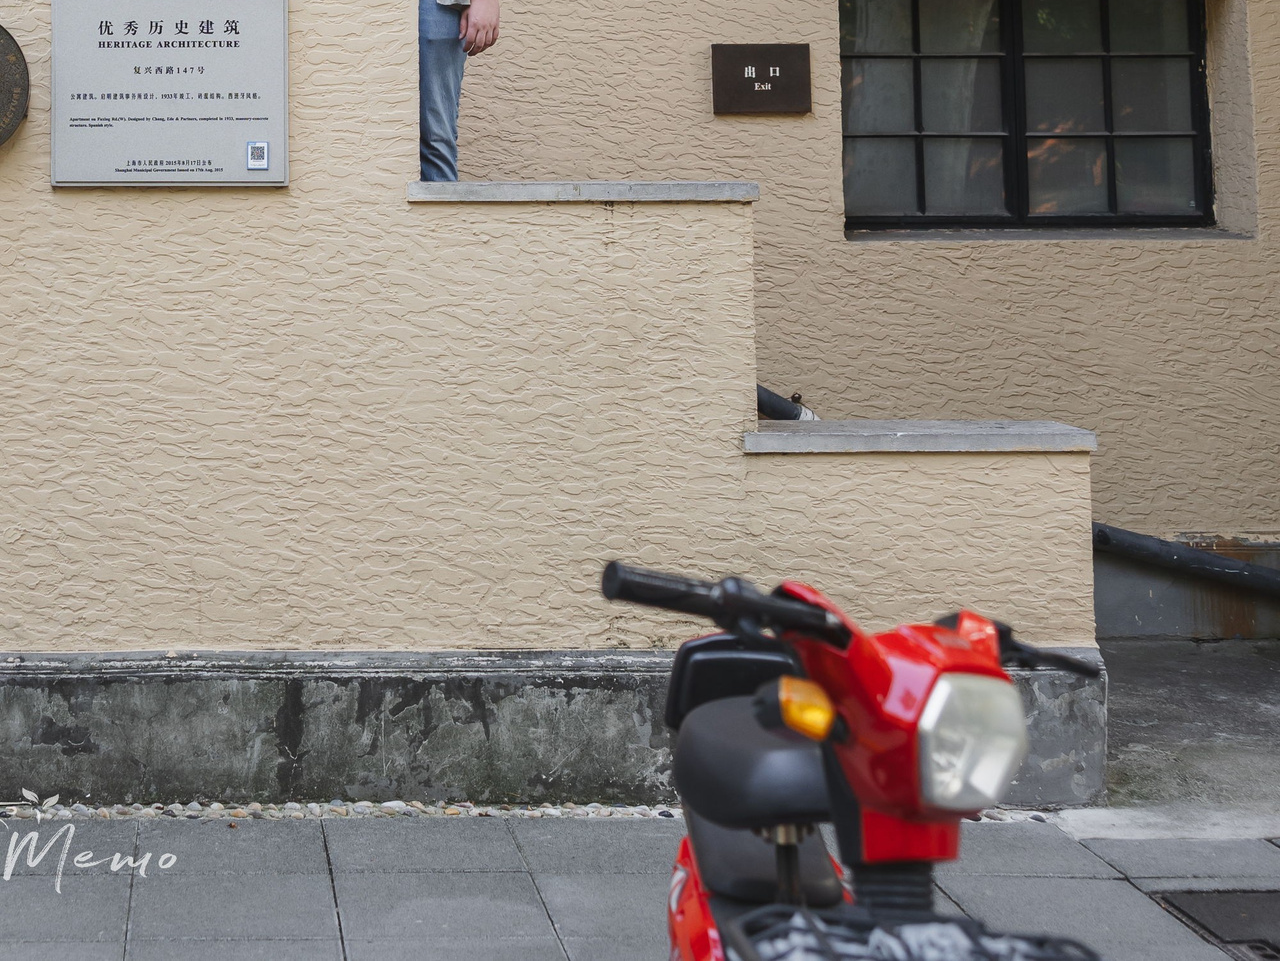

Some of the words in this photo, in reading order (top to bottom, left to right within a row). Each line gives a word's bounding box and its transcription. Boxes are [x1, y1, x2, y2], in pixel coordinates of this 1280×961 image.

[98, 19, 240, 36] 优秀历史建筑
[98, 40, 152, 49] HERITAGE
[156, 40, 240, 49] ARCHITECTURE
[133, 65, 205, 75] 复兴西路147号
[744, 65, 780, 78] 出口
[754, 82, 772, 91] Exit
